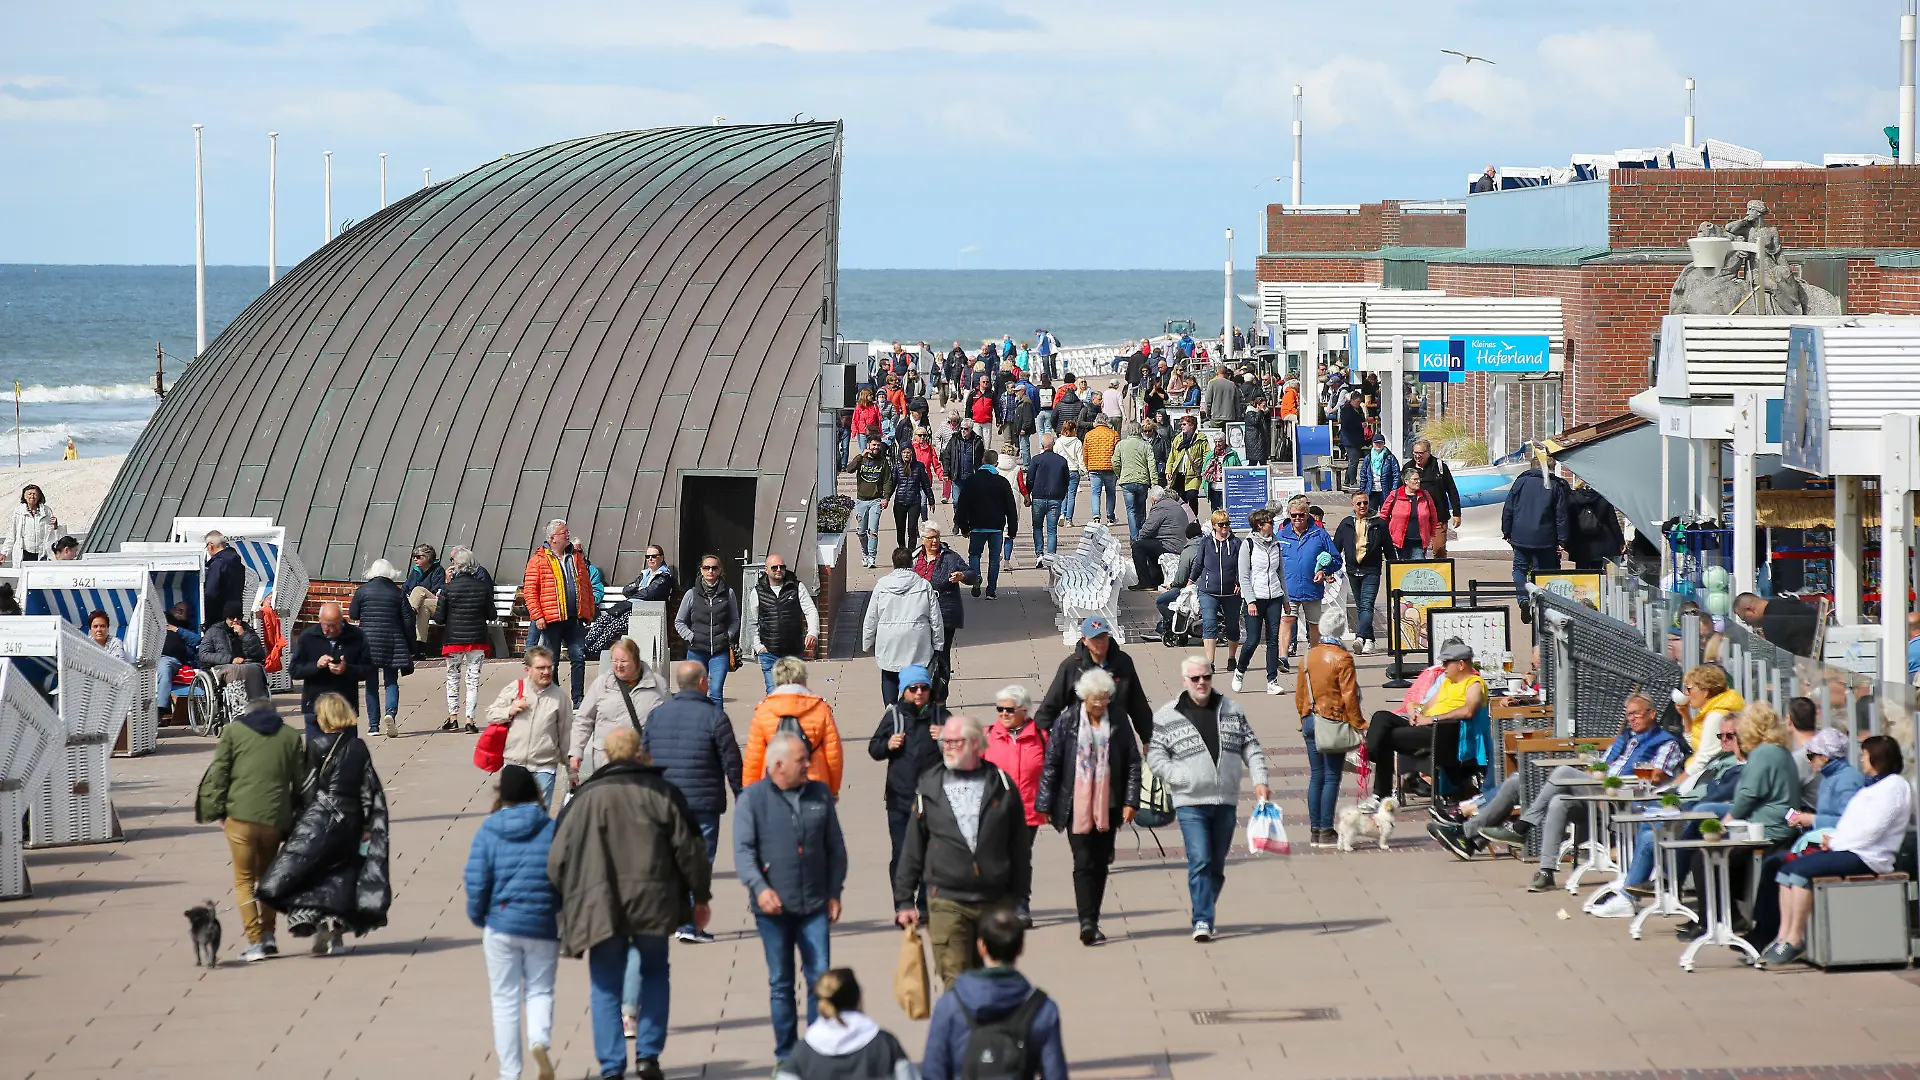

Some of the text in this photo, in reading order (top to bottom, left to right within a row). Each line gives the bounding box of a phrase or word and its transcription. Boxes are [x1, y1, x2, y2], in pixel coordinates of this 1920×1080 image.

[1472, 340, 1496, 348] Kleines
[1423, 354, 1461, 368] Kölln
[1476, 350, 1543, 366] Haferland
[73, 577, 95, 587] 3421
[4, 642, 22, 653] 3419
